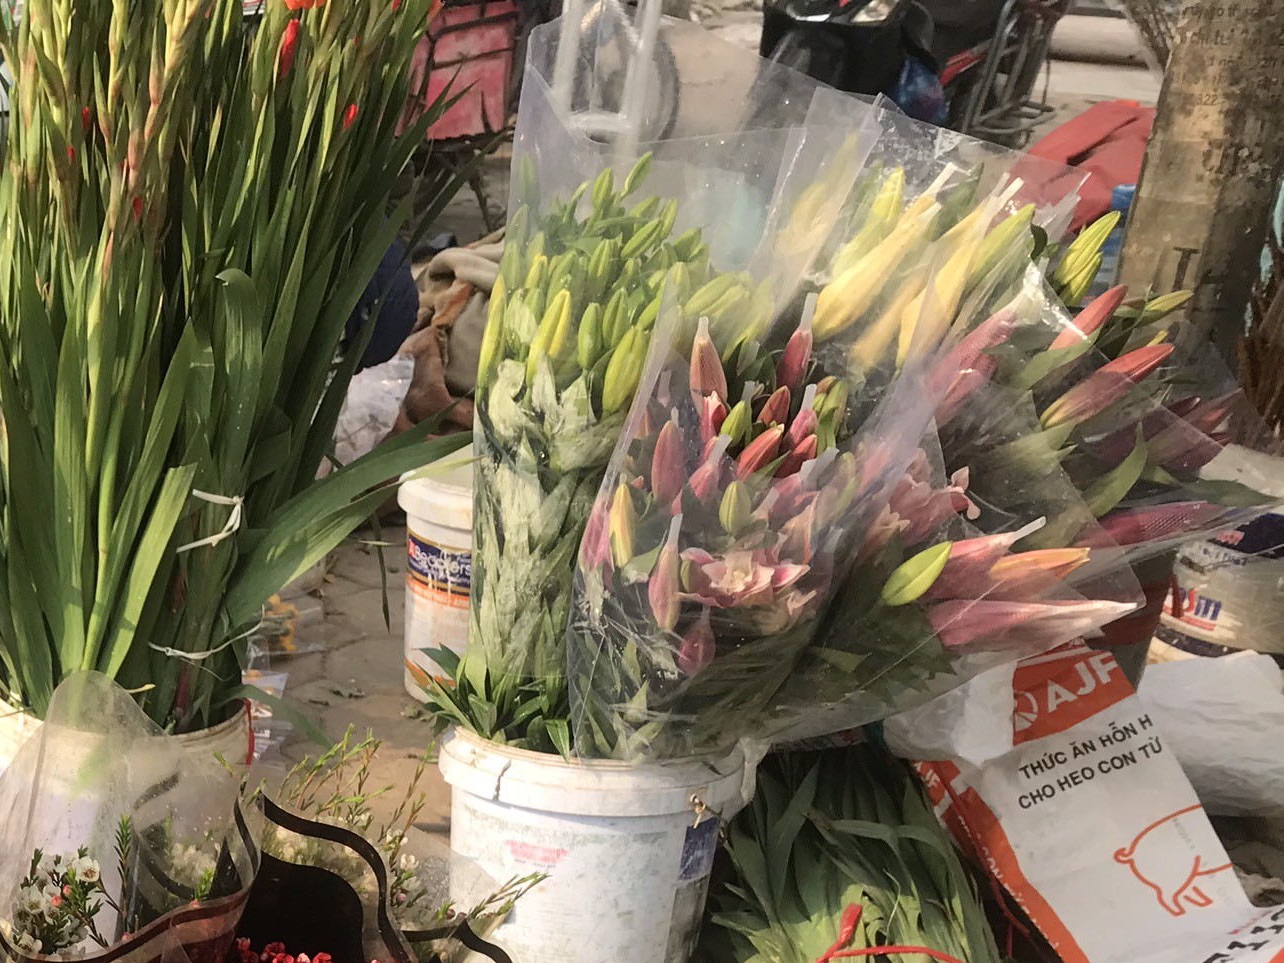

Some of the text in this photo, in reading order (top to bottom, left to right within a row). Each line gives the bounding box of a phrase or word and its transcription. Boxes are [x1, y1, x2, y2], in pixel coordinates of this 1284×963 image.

[1019, 752, 1067, 780] THỨC
[1069, 741, 1097, 759] ĂN
[1099, 721, 1138, 747] HỖN
[1018, 783, 1056, 810] CHO
[1057, 766, 1095, 791] HEO
[1097, 751, 1137, 774] CON
